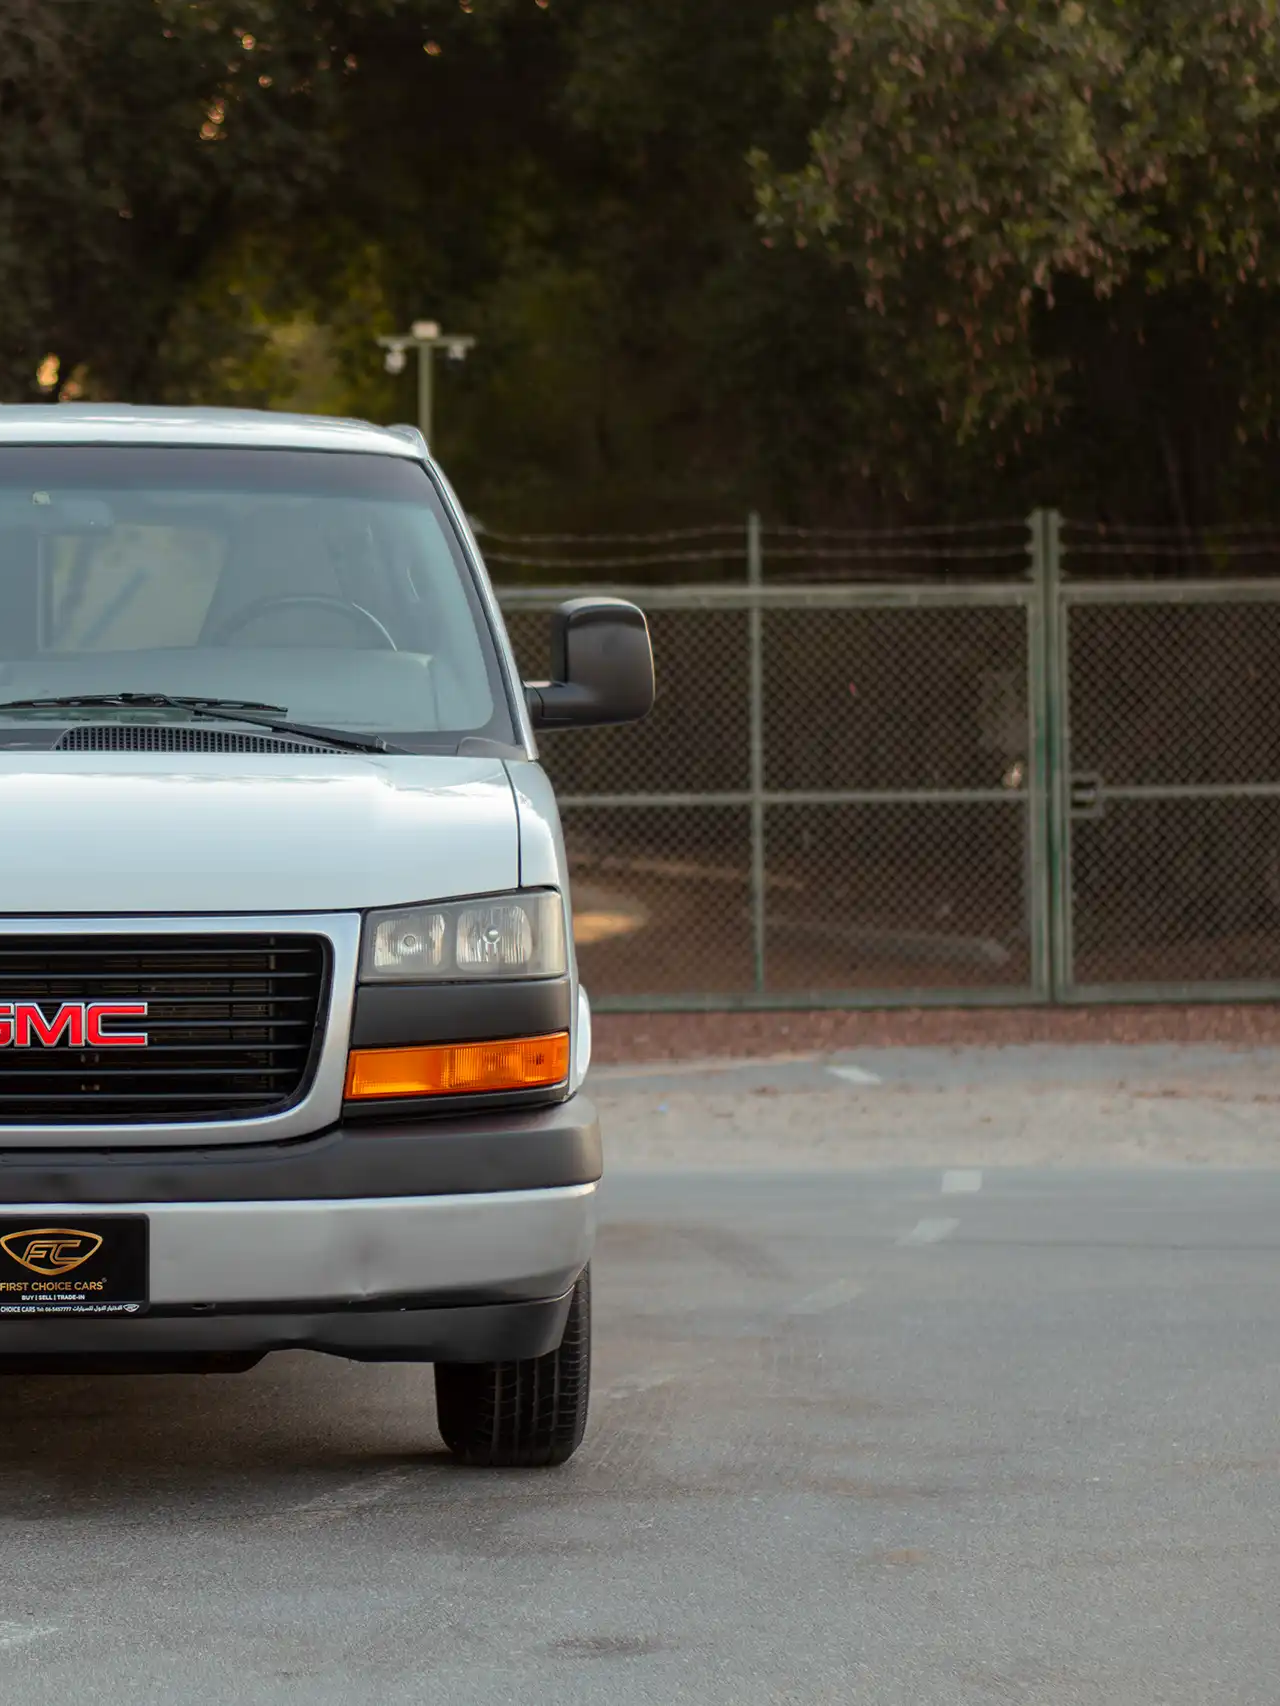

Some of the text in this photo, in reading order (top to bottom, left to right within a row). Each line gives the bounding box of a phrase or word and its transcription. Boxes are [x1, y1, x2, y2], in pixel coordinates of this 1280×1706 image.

[0, 1281, 103, 1291] FIRST CHOICE CARS
